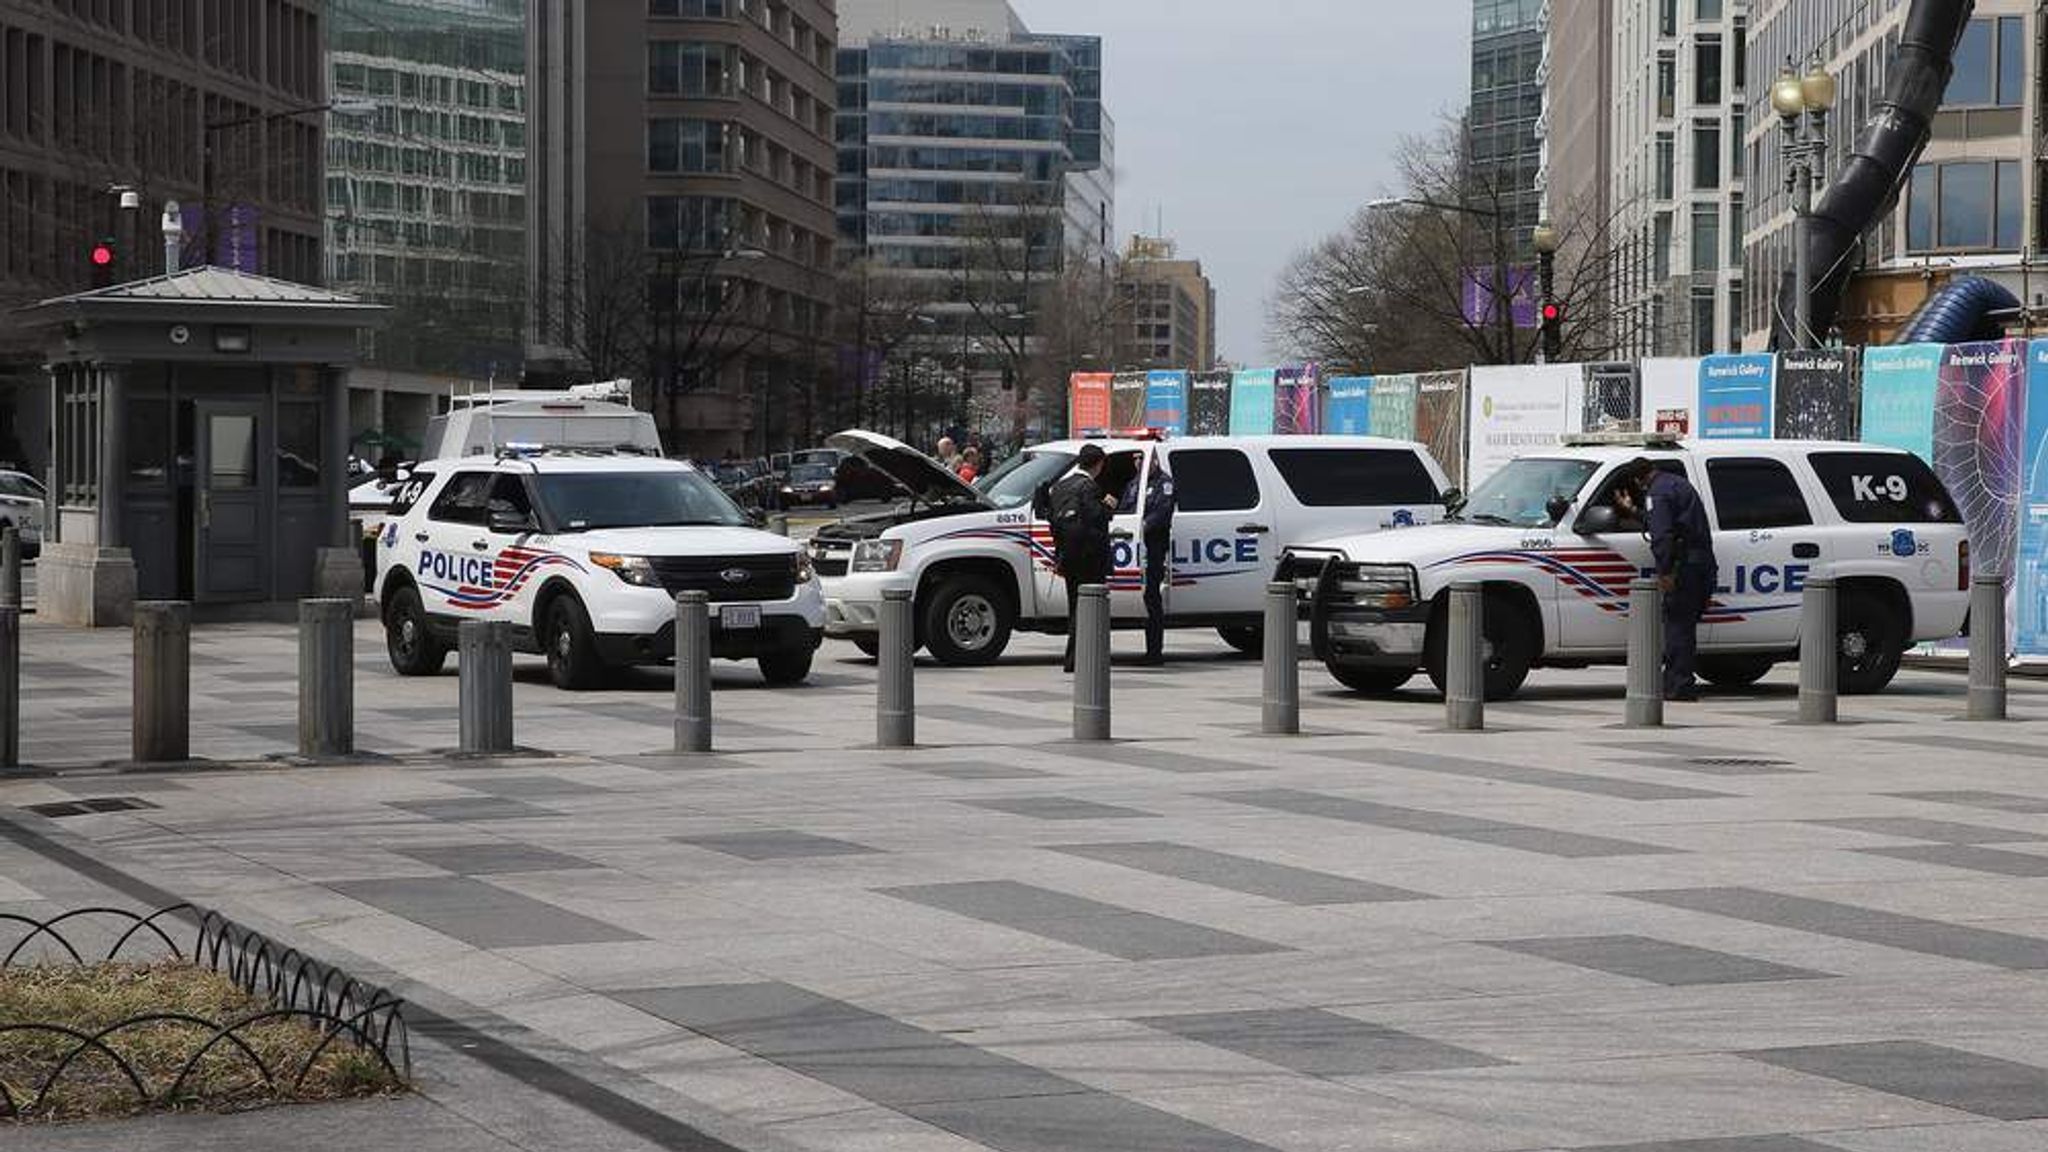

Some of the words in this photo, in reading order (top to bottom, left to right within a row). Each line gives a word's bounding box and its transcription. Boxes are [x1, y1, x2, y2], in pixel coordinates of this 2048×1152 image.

[1739, 362, 1765, 378] Gallery
[1784, 358, 1815, 371] Renwick
[1817, 357, 1844, 374] Gallery
[1851, 475, 1907, 501] K-9
[1111, 538, 1259, 568] OLICE
[418, 551, 493, 588] POLICE
